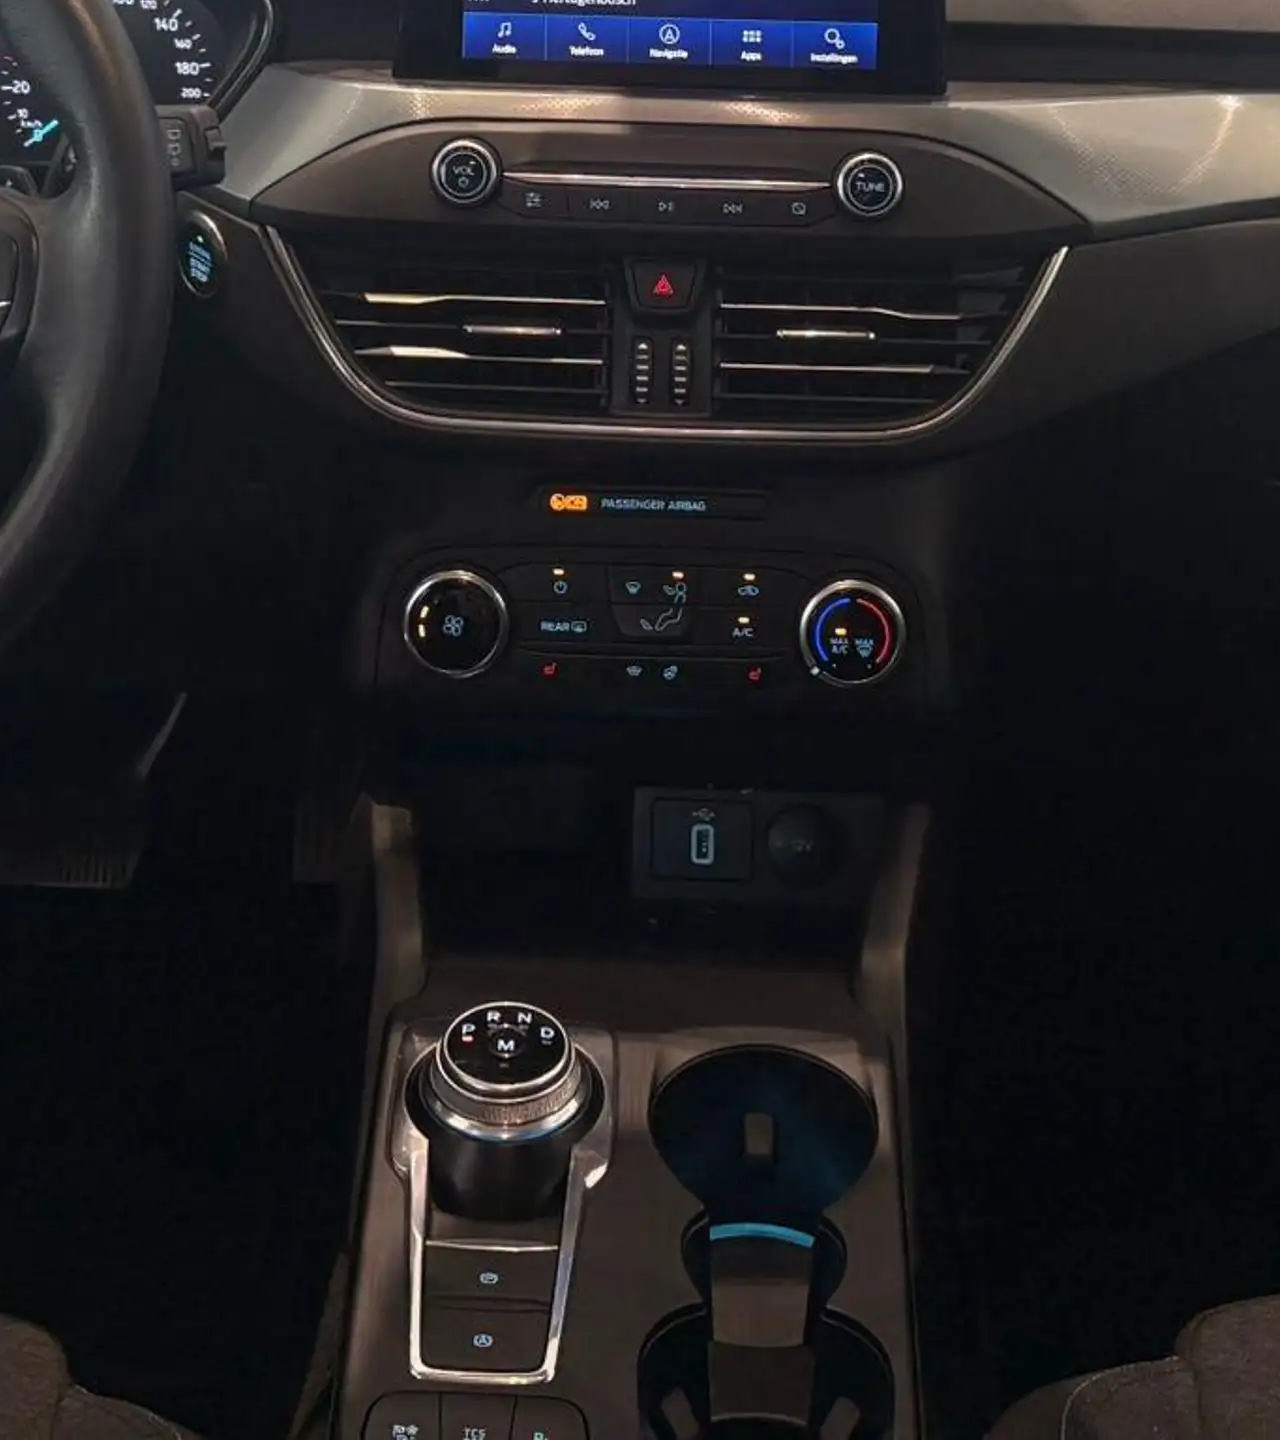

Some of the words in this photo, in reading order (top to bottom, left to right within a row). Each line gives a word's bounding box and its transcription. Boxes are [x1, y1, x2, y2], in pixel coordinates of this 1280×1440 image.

[154, 17, 179, 31] 140
[492, 44, 517, 55] Audio
[741, 50, 762, 62] Apps
[175, 61, 200, 75] 180
[12, 80, 31, 94] 20
[180, 87, 202, 99] 200
[452, 165, 475, 176] VOL
[601, 498, 666, 511] PASSENGER
[667, 500, 706, 512] AIRBAG
[540, 621, 570, 633] REAR
[732, 627, 754, 638] A/C
[486, 1010, 501, 1023] R
[517, 1012, 532, 1024] N
[462, 1023, 476, 1035] P
[540, 1026, 555, 1040] D
[497, 1039, 515, 1051] M
